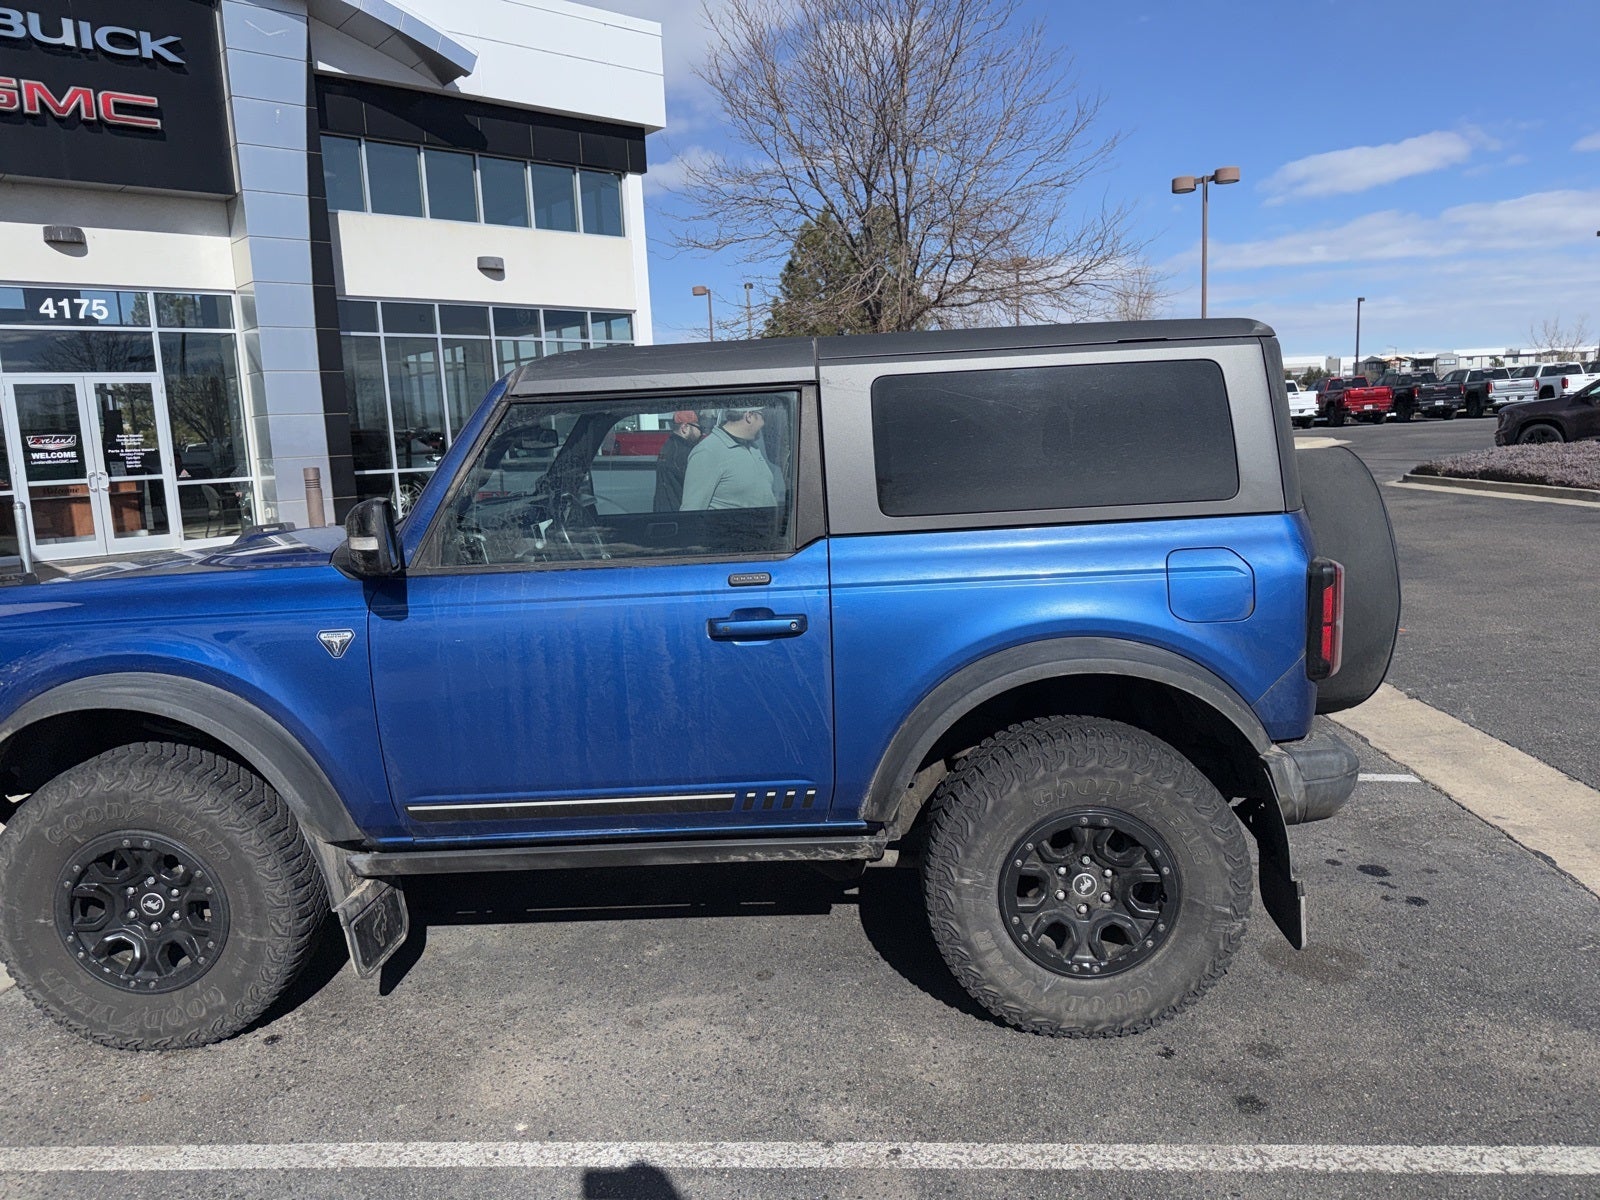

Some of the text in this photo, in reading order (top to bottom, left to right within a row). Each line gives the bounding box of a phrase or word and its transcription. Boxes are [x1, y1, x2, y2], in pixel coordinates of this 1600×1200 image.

[0, 7, 186, 65] BUICK
[38, 297, 109, 320] 4175
[31, 451, 77, 460] WELCOME
